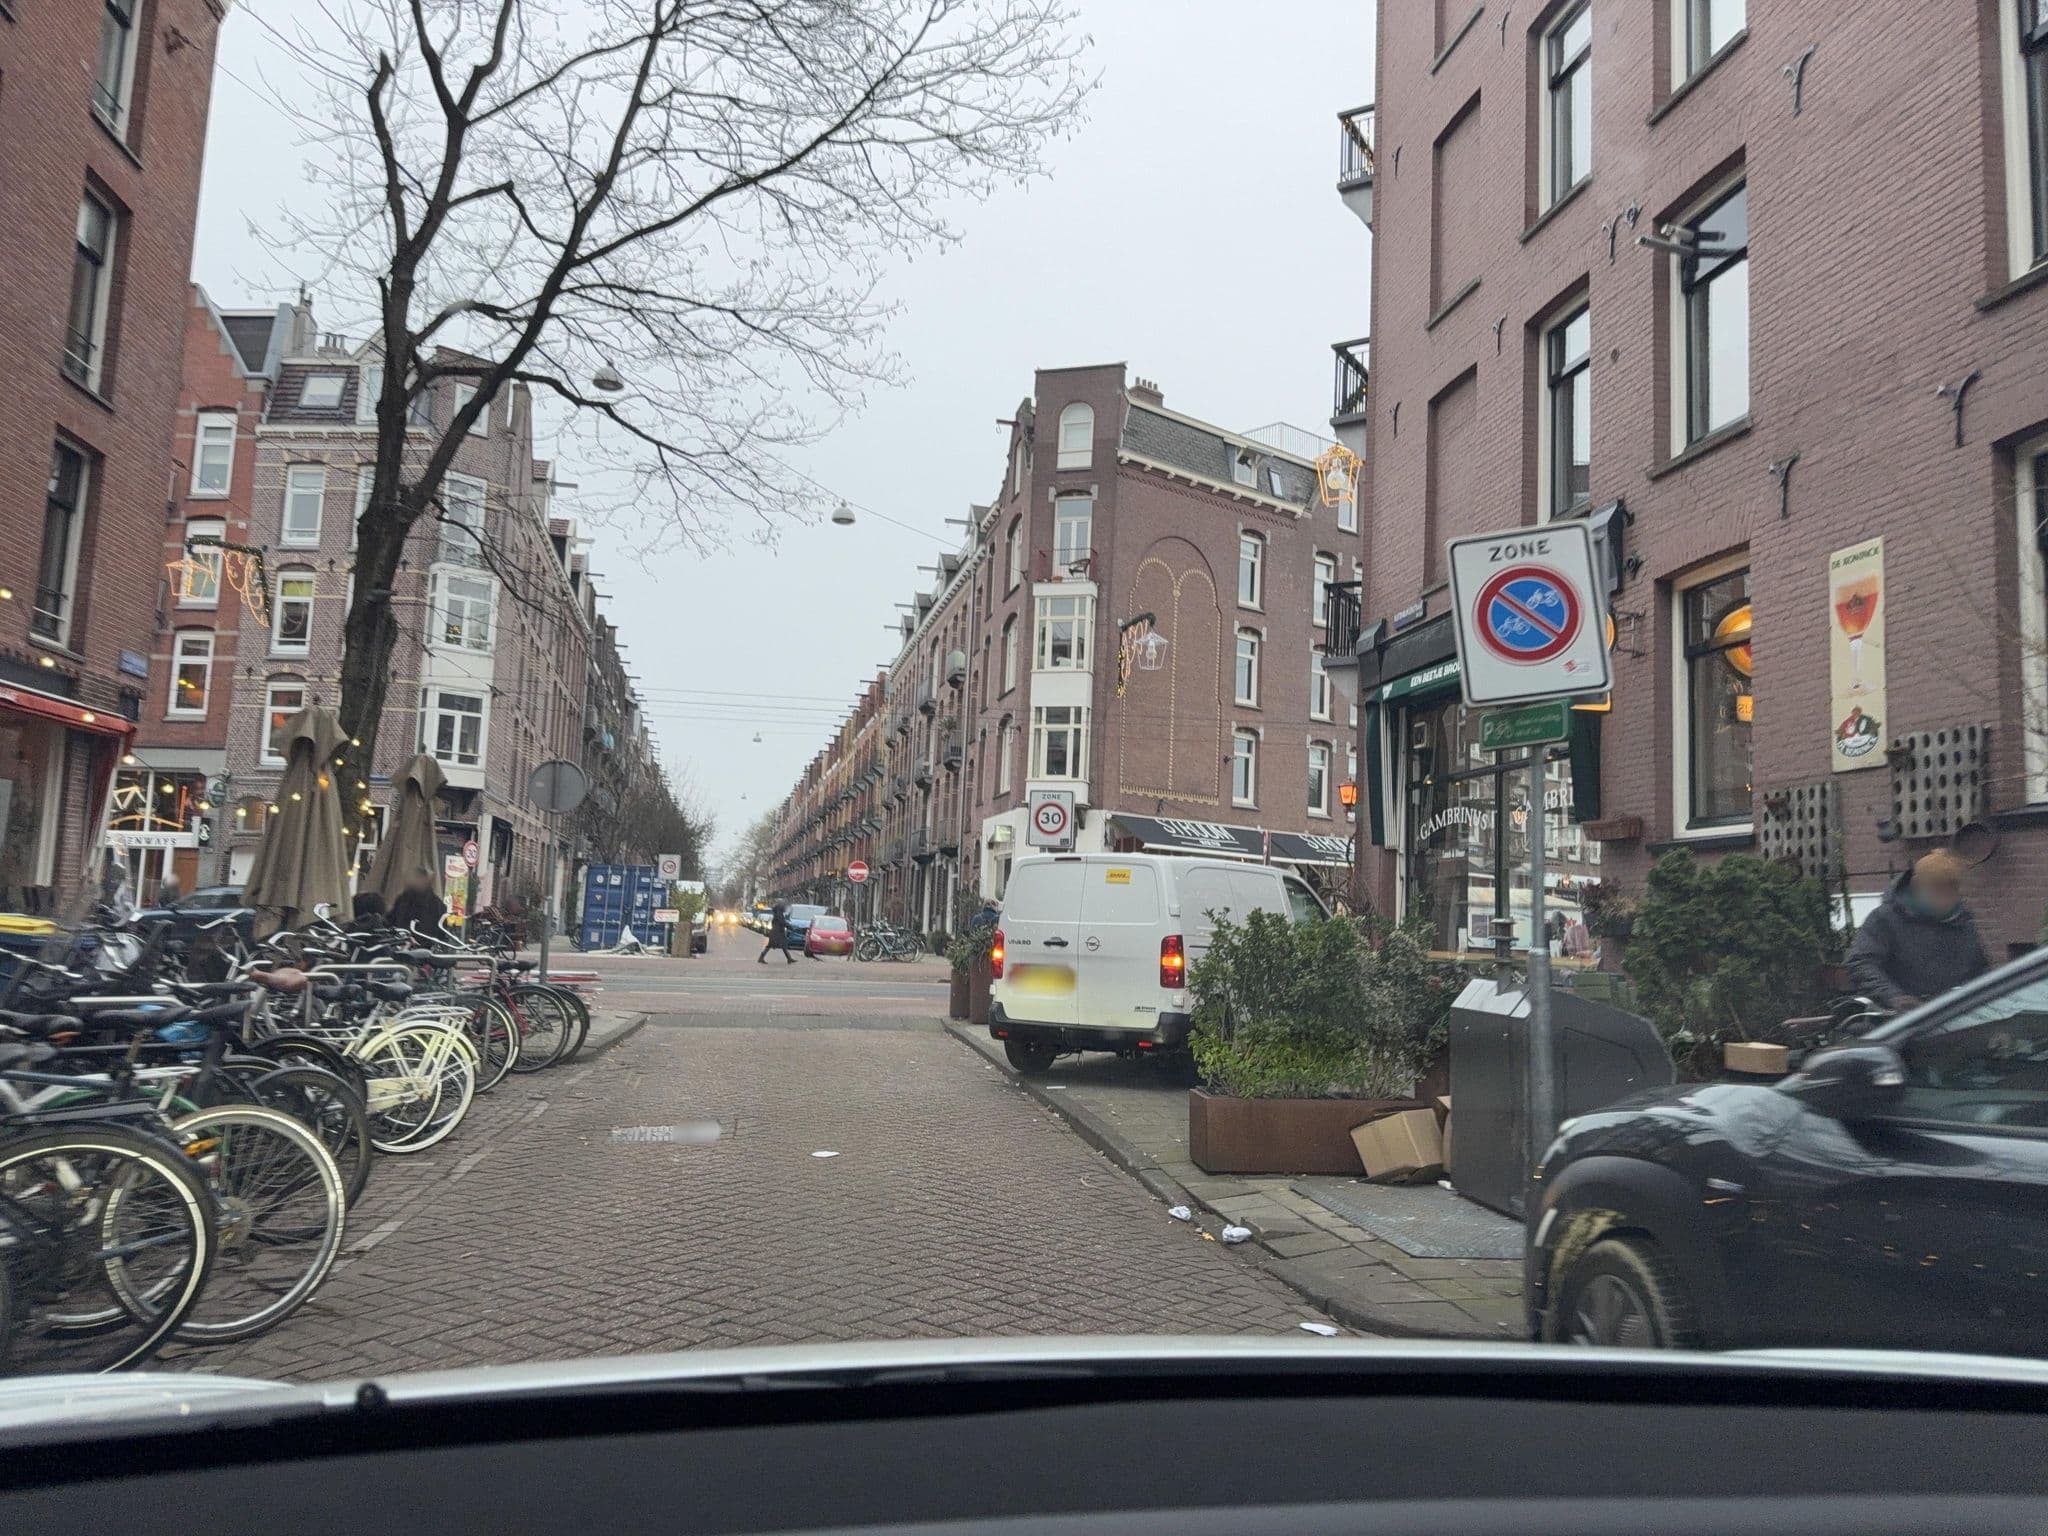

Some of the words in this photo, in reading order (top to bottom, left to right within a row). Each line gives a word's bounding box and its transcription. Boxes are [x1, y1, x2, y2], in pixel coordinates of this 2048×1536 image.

[1488, 539, 1551, 562] ZONE
[1040, 812, 1061, 825] 30
[1420, 806, 1489, 840] GAMBRINUS
